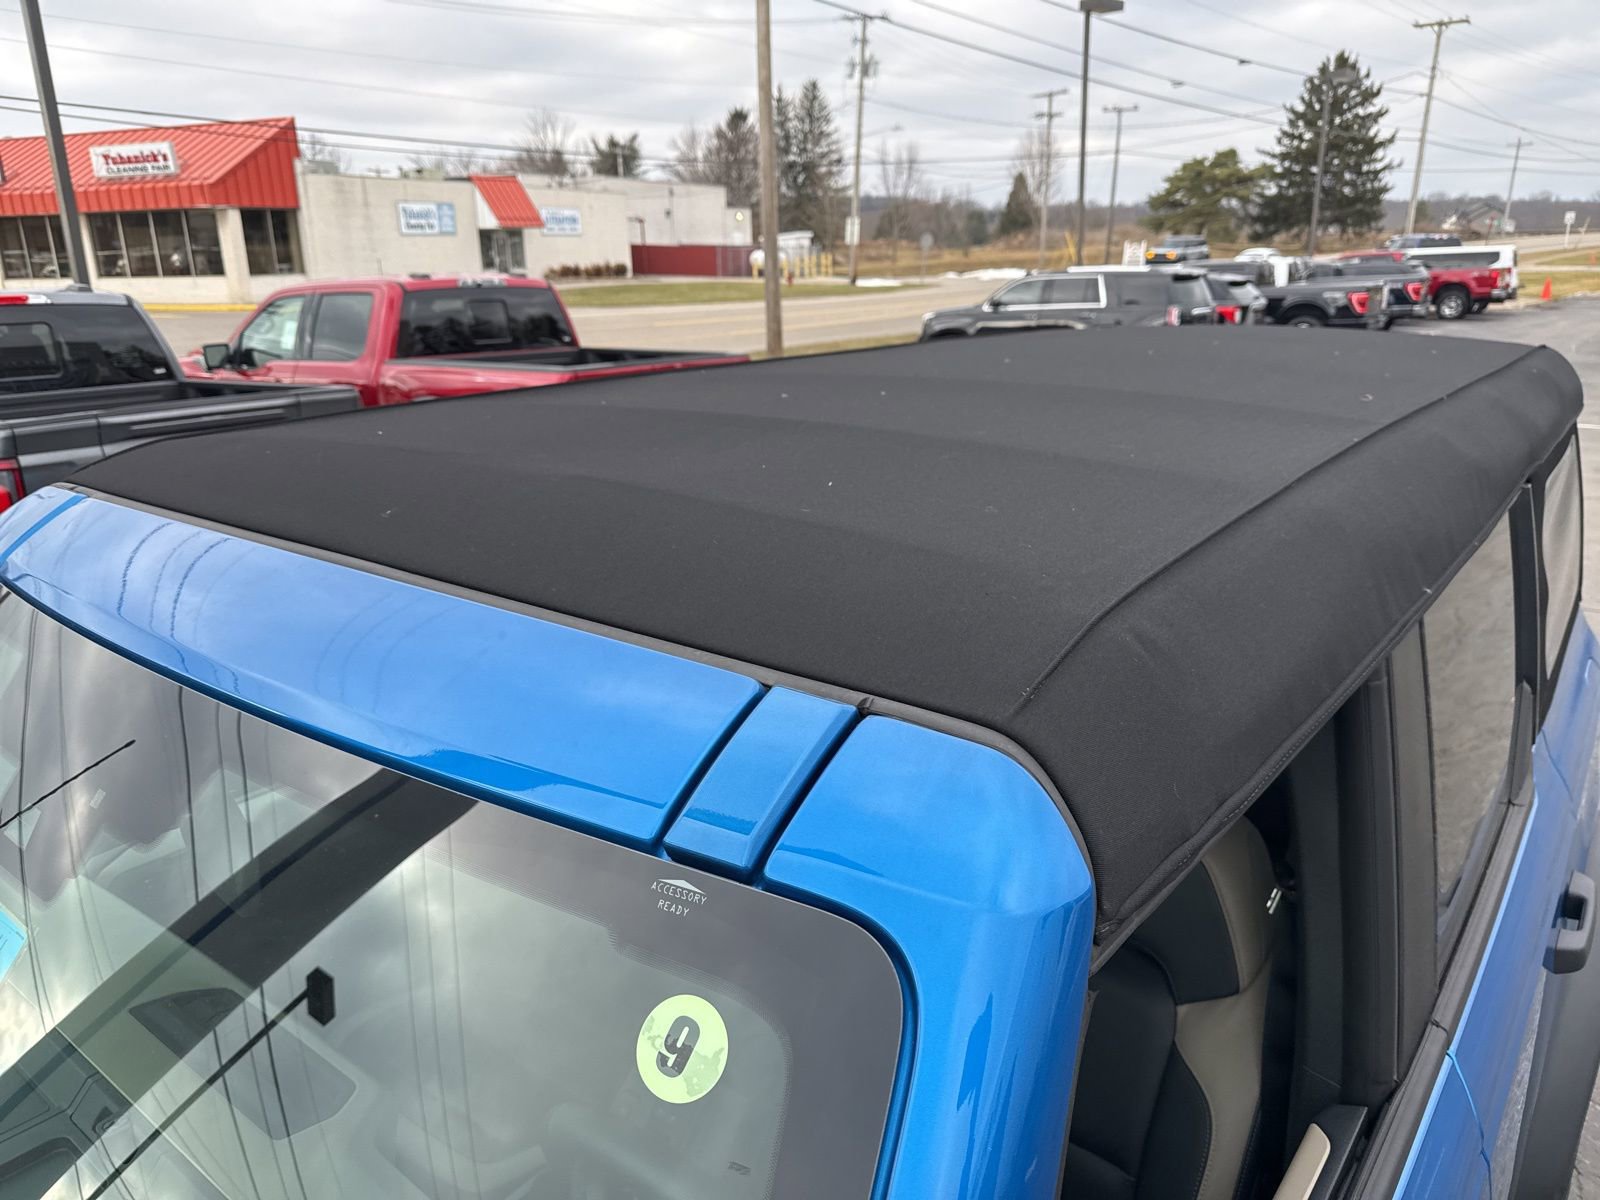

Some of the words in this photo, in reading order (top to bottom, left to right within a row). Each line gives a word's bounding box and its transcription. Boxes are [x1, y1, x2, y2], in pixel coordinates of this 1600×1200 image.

[107, 165, 149, 175] CLEANING
[650, 881, 707, 905] ACCESSORY
[657, 899, 690, 917] READY
[655, 1015, 701, 1078] 9
